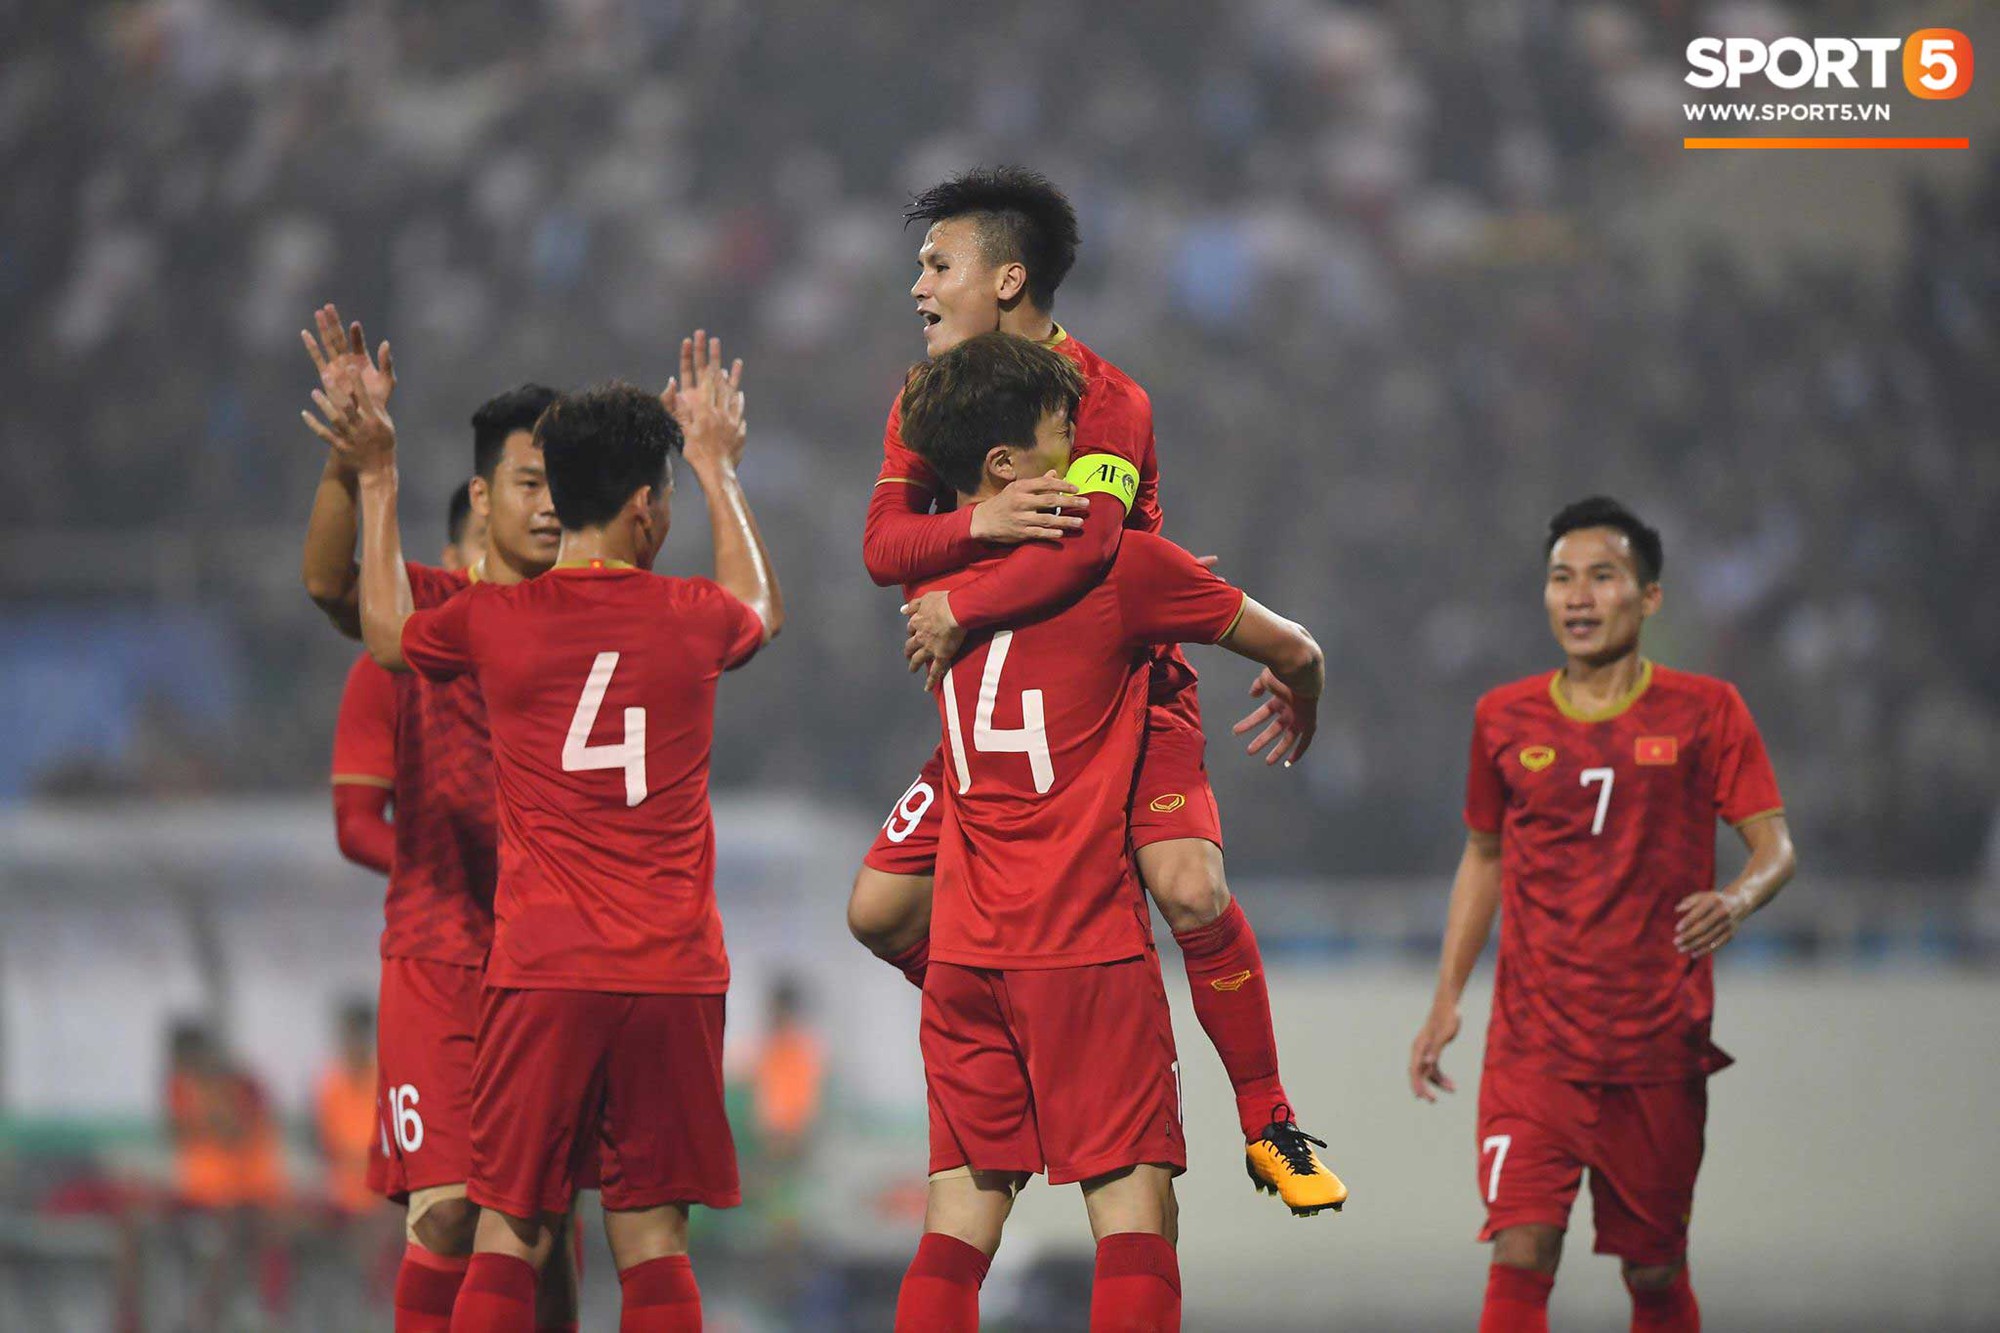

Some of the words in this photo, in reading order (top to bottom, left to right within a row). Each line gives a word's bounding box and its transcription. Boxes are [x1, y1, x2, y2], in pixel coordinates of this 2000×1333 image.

[561, 651, 647, 807] 4
[943, 630, 1055, 794] 14
[1580, 767, 1615, 835] 7
[389, 1084, 424, 1153] 16
[1483, 1135, 1512, 1203] 7
